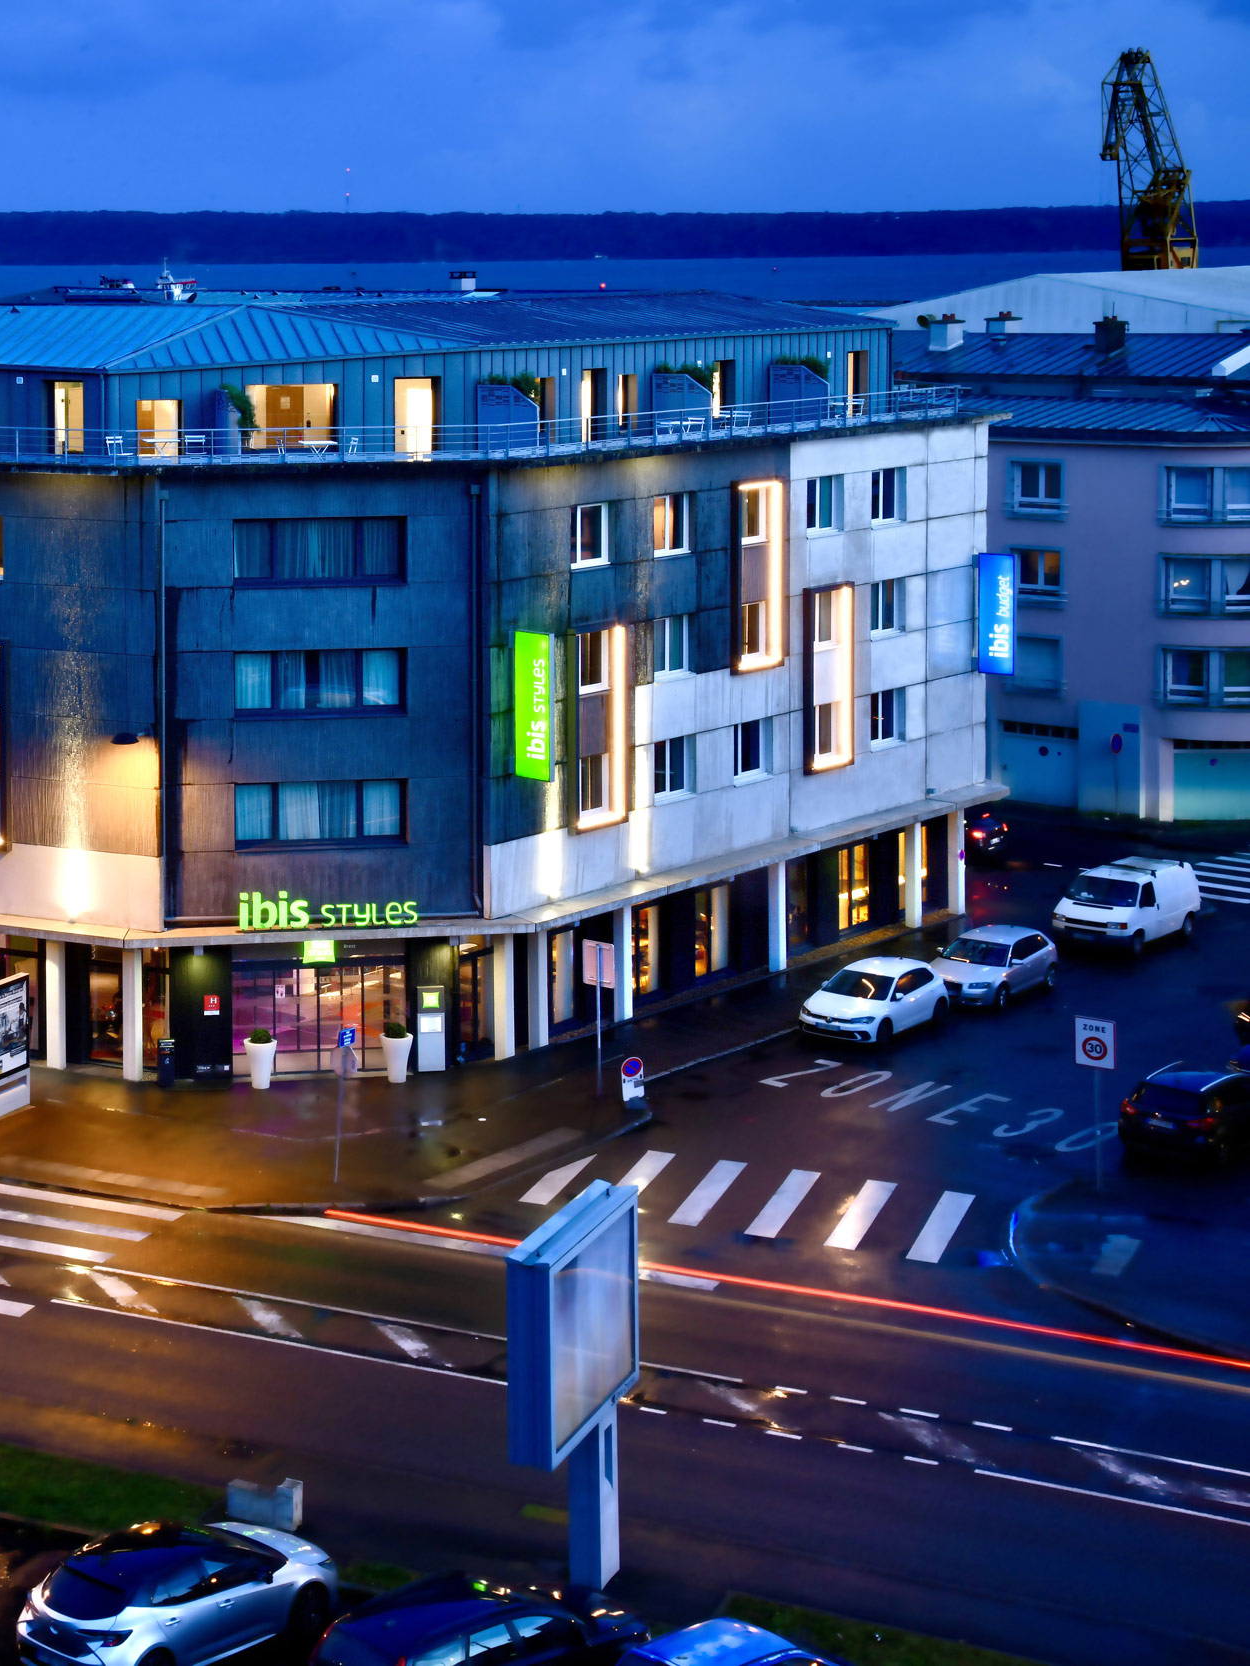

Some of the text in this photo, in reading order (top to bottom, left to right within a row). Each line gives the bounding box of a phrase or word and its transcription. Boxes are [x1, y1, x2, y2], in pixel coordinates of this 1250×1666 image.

[989, 575, 1013, 658] ibis budget
[526, 720, 546, 760] ibis
[239, 890, 310, 931] ibis
[1082, 1023, 1107, 1034] ZONE
[1087, 1042, 1103, 1055] 30
[759, 1058, 1119, 1152] ZONE 30
